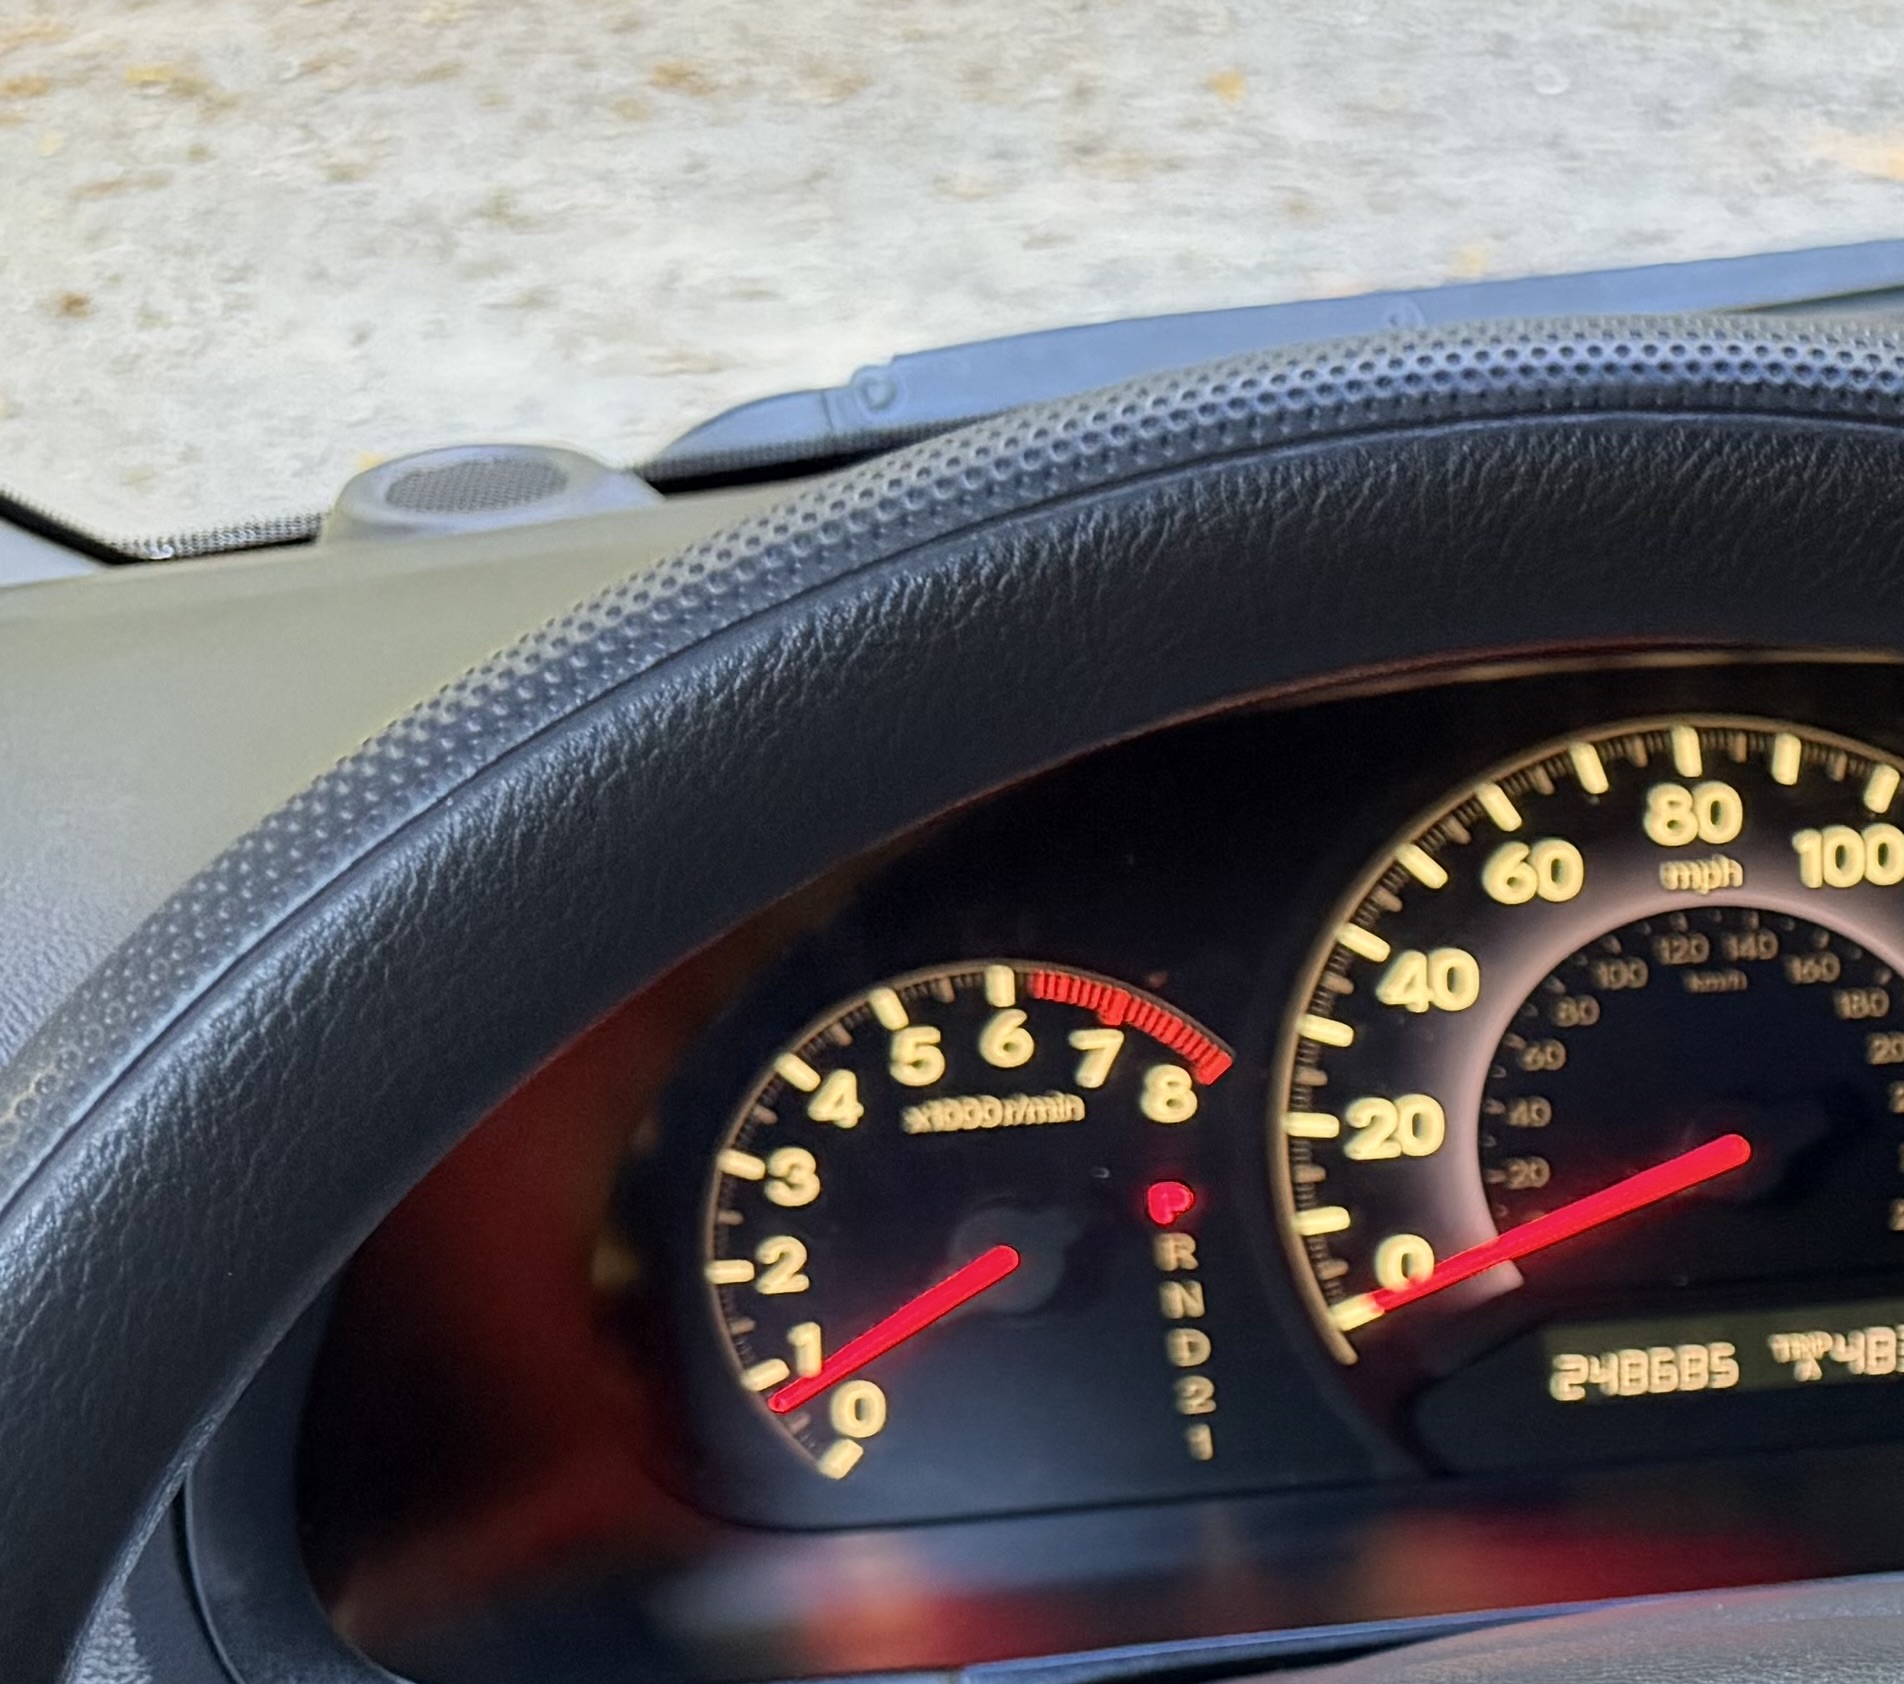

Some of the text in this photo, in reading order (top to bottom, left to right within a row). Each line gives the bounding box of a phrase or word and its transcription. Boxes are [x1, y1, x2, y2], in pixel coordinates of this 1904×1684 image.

[1642, 779, 1744, 847] 80
[1482, 838, 1585, 905] 60
[1659, 854, 1744, 896] mph
[1654, 932, 1710, 965] 120
[1722, 929, 1779, 962] 140
[1784, 952, 1841, 985] 160
[1376, 946, 1481, 1014] 40
[1594, 957, 1648, 991] 100
[1552, 994, 1600, 1028] 80
[1834, 987, 1890, 1020] 180
[890, 1026, 946, 1087] 5
[979, 1008, 1035, 1068] 6
[1069, 1028, 1125, 1088] 7
[1520, 1039, 1567, 1071] 60
[807, 1069, 865, 1129] 4
[1140, 1063, 1198, 1124] 8
[1505, 1097, 1552, 1128] 40
[1343, 1093, 1446, 1160] 20
[764, 1147, 821, 1207] 3
[1504, 1156, 1551, 1190] 20
[755, 1235, 810, 1295] 2
[1153, 1232, 1200, 1271] R
[1375, 1234, 1436, 1292] 0
[1159, 1280, 1206, 1320] N
[788, 1321, 823, 1377] 1
[1166, 1327, 1213, 1368] D
[1549, 1341, 1740, 1402] 248685
[831, 1380, 887, 1438] 0
[1175, 1375, 1217, 1414] 2
[1184, 1424, 1214, 1461] 1
